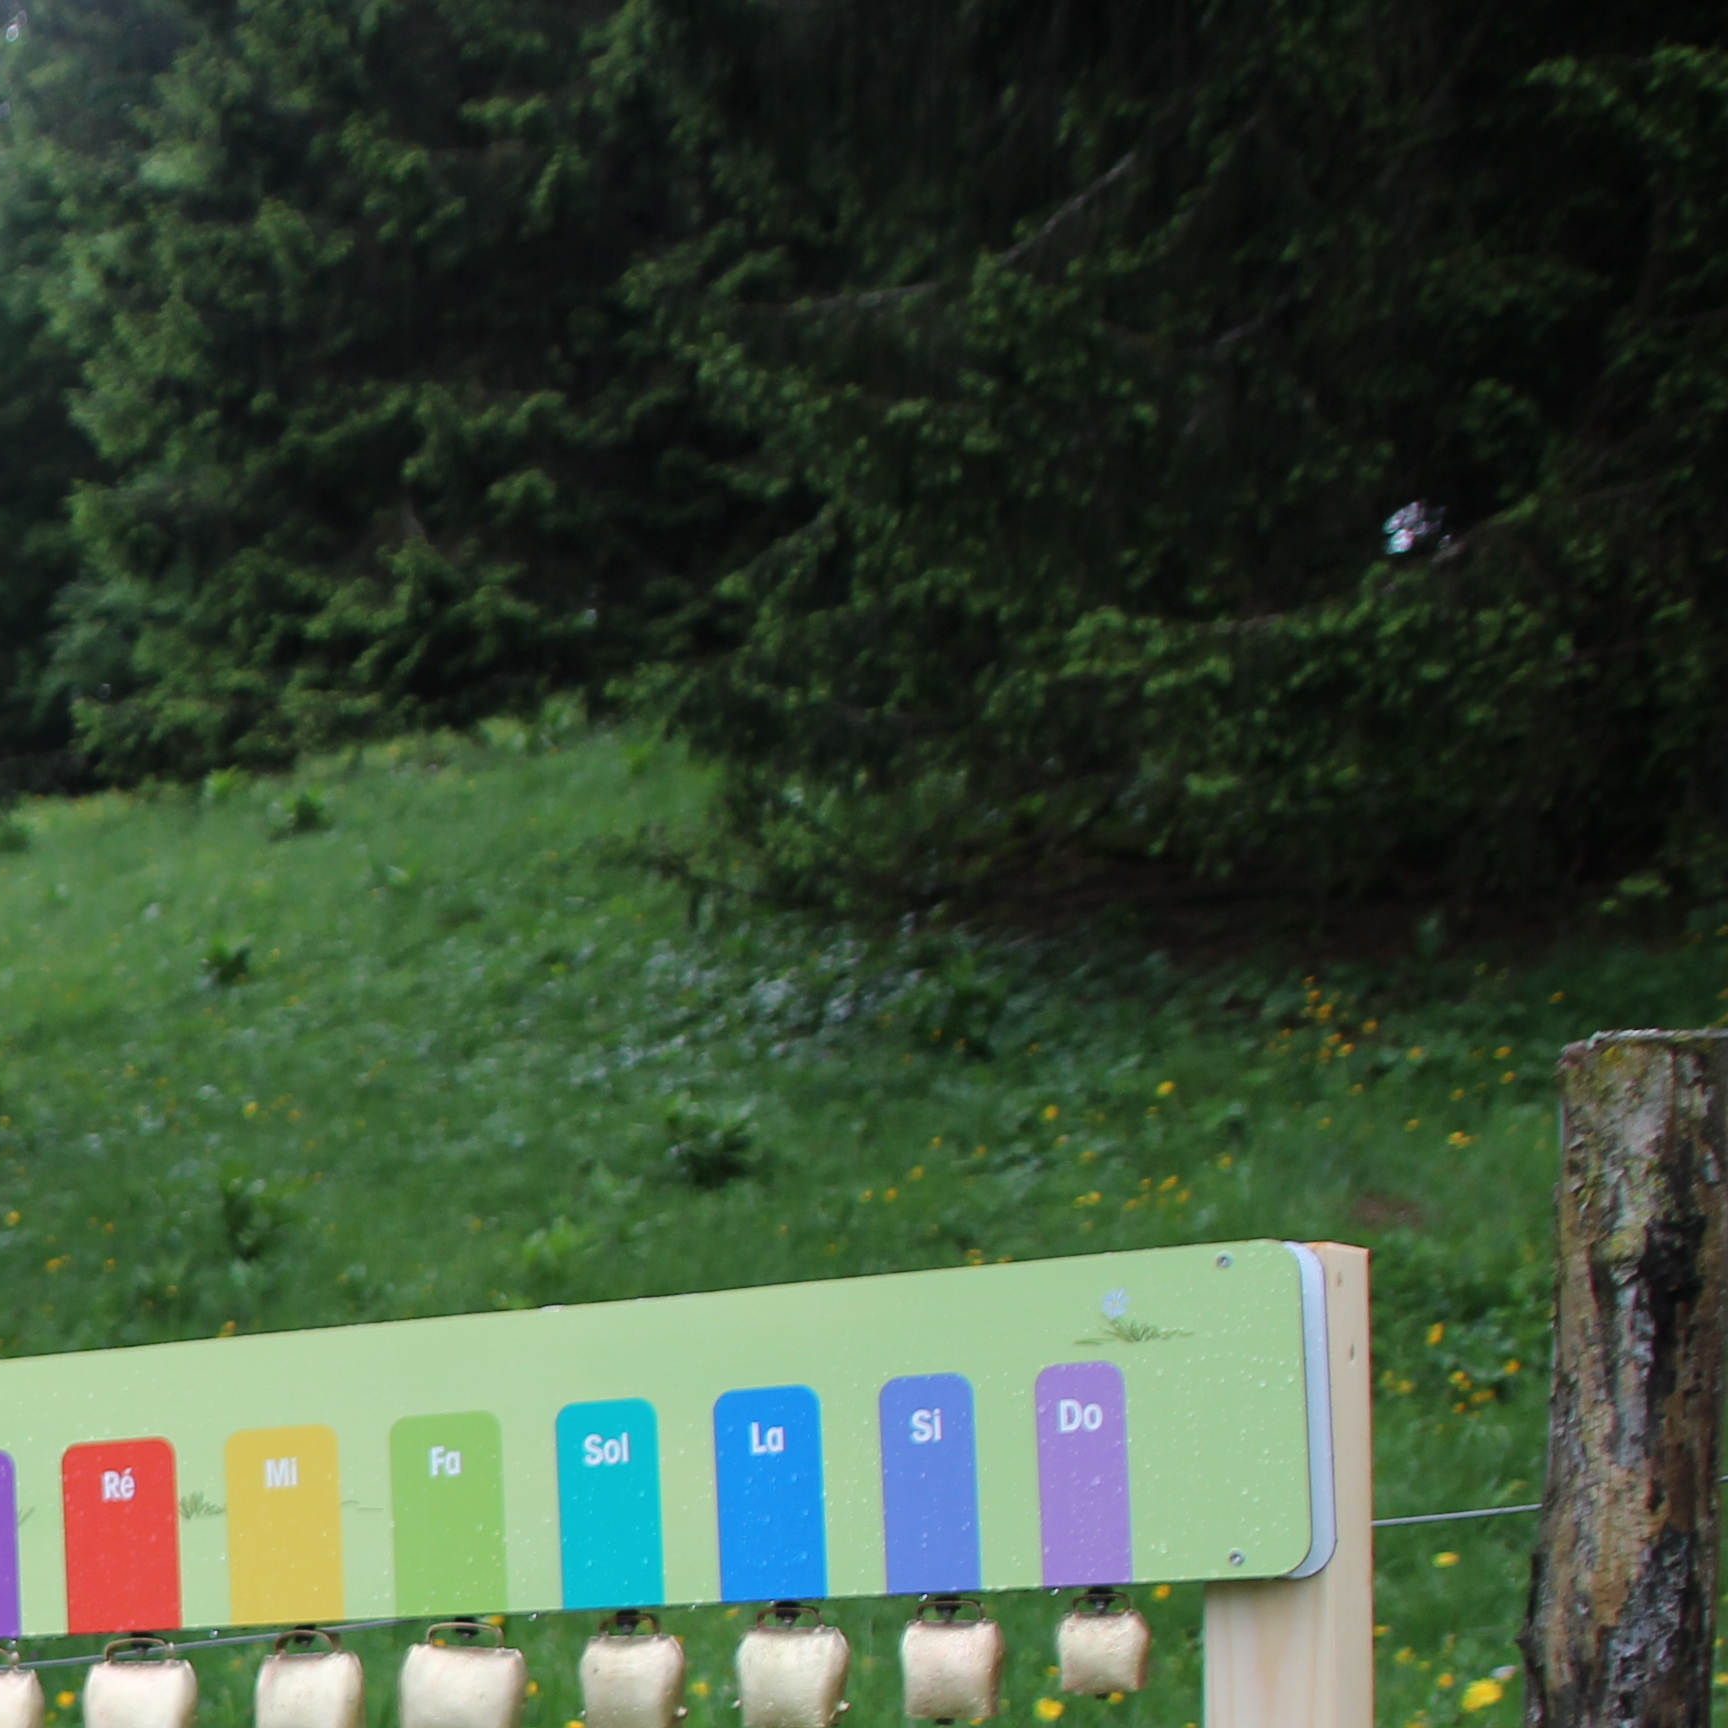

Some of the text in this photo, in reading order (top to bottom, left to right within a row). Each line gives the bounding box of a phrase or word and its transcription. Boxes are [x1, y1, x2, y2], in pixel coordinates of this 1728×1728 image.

[101, 1467, 136, 1502] Ré
[263, 1457, 299, 1489] Mi
[428, 1445, 463, 1478] Fa
[583, 1432, 630, 1467] Sol
[749, 1421, 785, 1456] La
[911, 1407, 942, 1444] Si
[1058, 1398, 1104, 1434] Do
